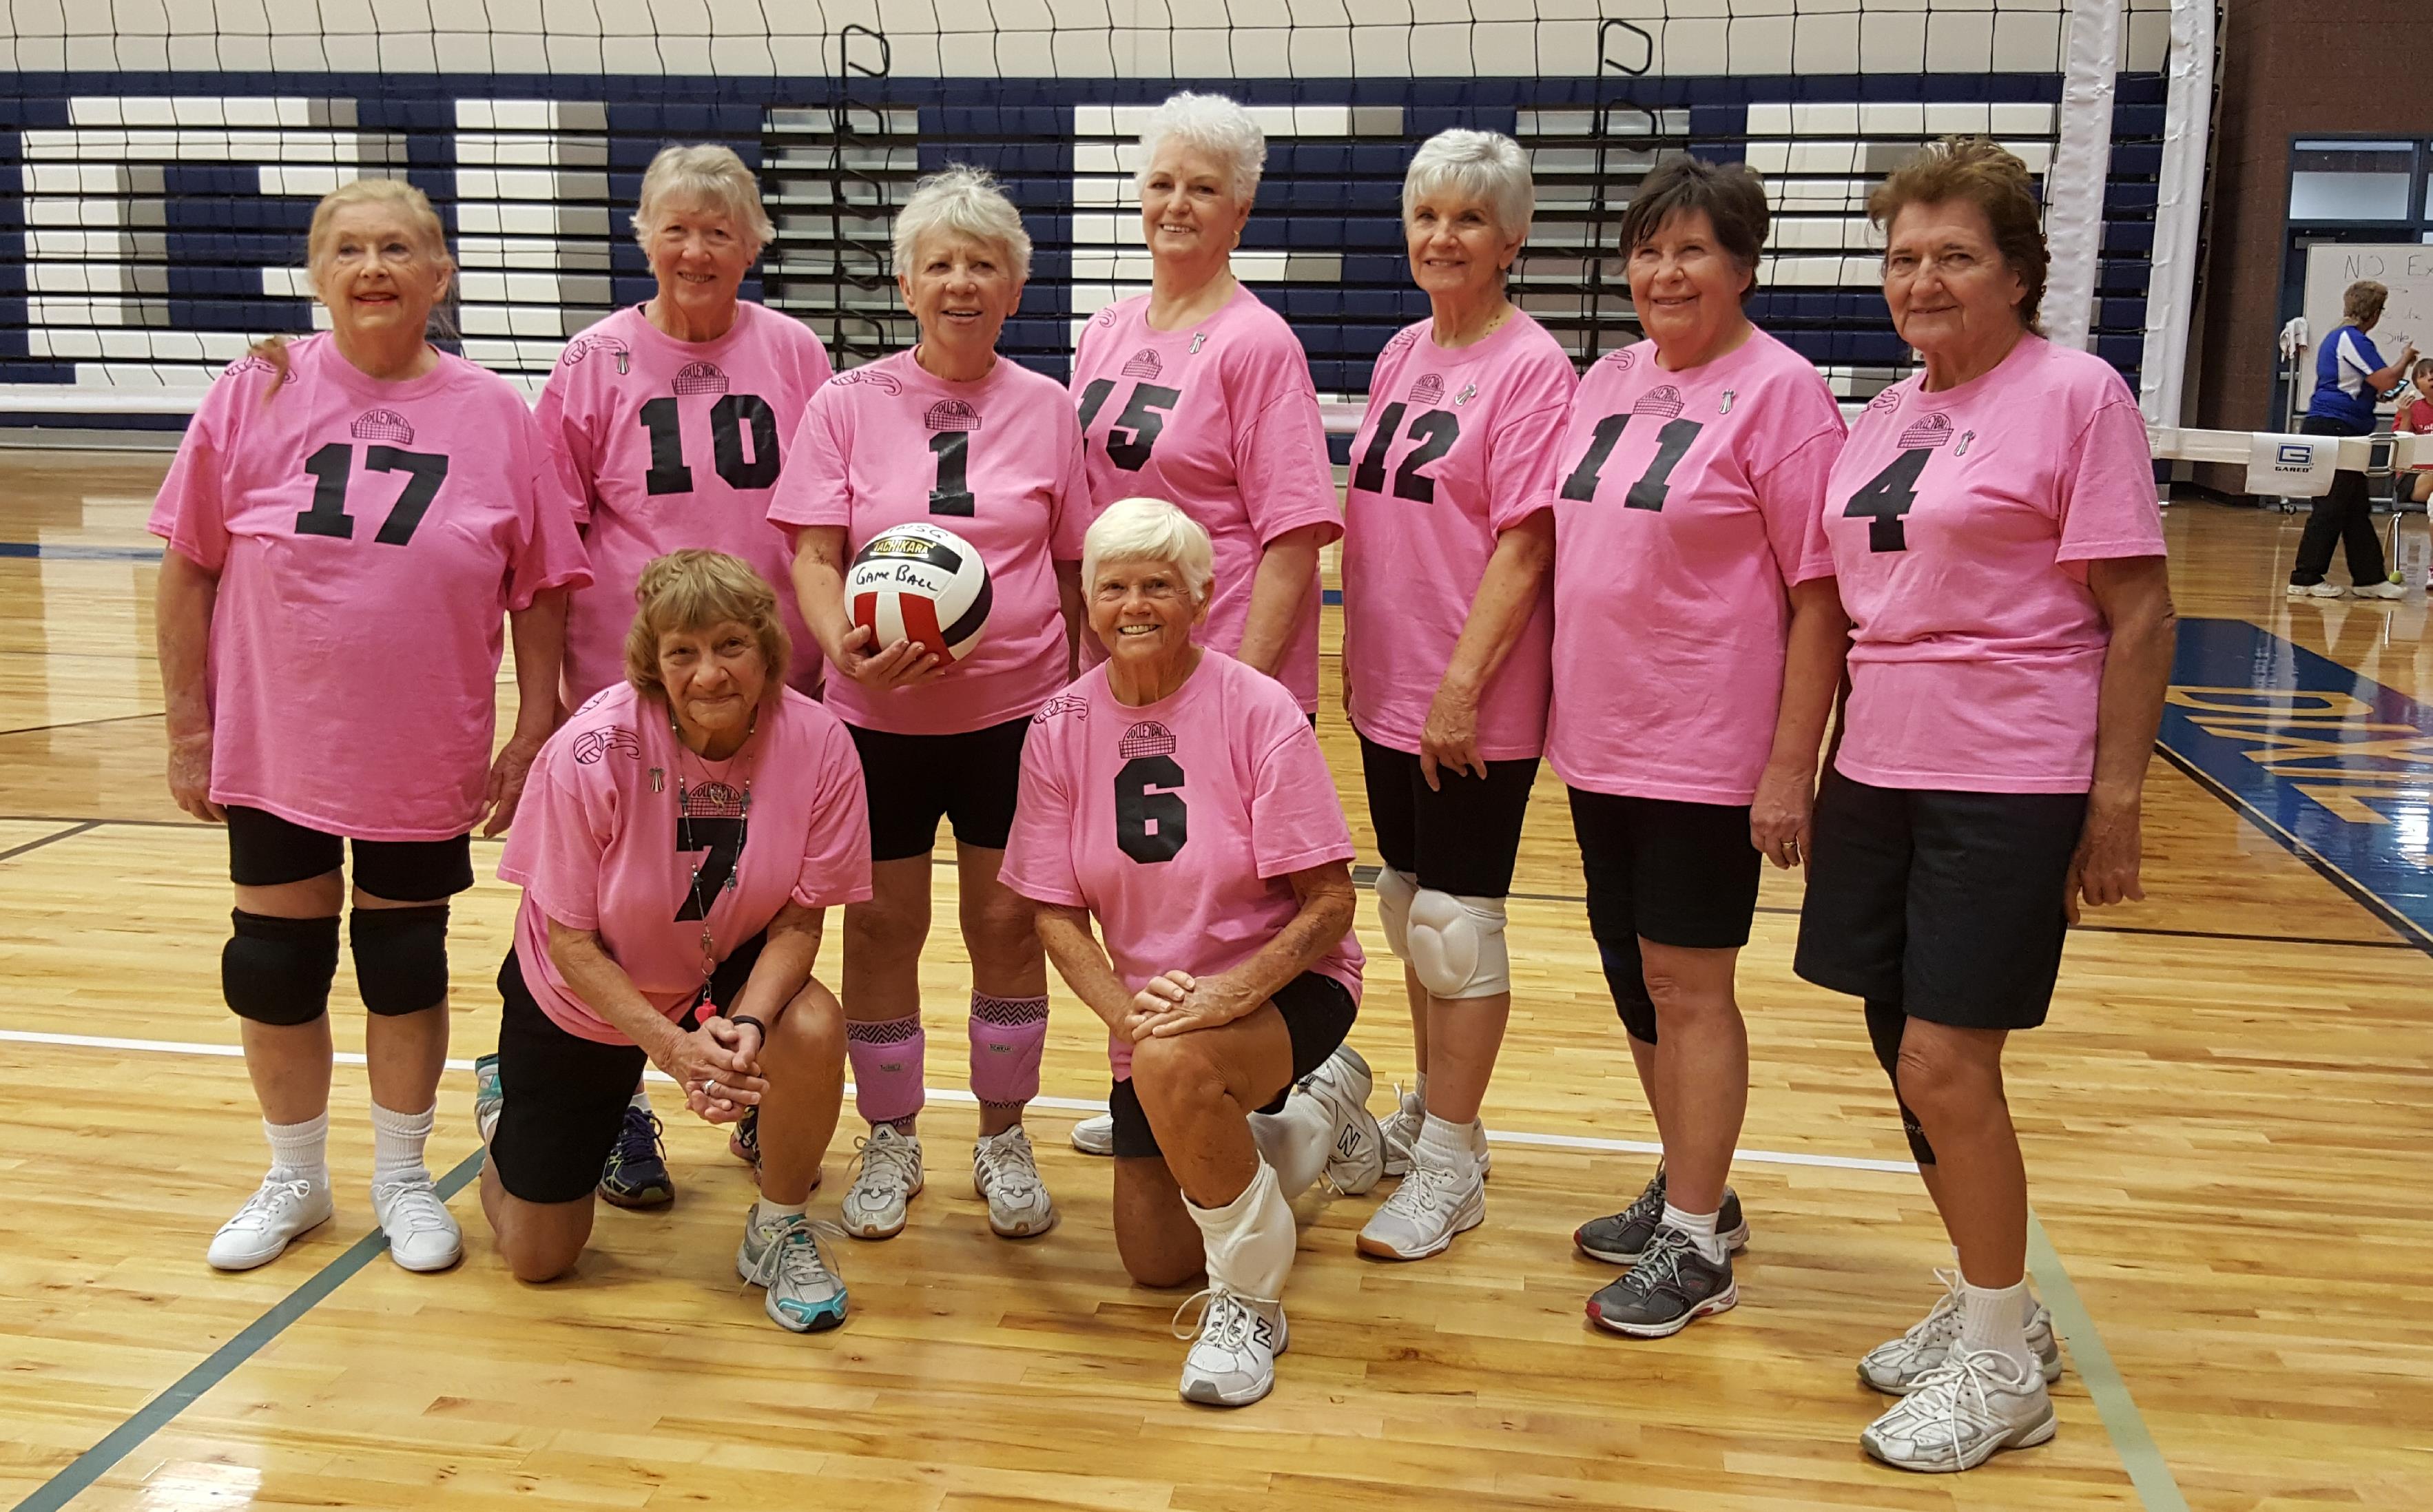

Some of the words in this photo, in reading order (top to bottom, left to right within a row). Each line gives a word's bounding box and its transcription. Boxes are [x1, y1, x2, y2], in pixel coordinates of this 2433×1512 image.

[2345, 254, 2385, 279] NO
[639, 395, 781, 495] 10
[929, 431, 975, 517] 1
[1078, 378, 1181, 472] 15
[1354, 402, 1460, 504] 12
[1560, 413, 1703, 512] 11
[294, 443, 448, 546] 17
[1843, 448, 1934, 552] 4
[873, 539, 929, 554] TACHIKARA
[895, 564, 939, 592] BALL
[1127, 721, 1168, 738] VOLLEYBALL
[1114, 755, 1188, 864] 6
[673, 818, 747, 922] 7
